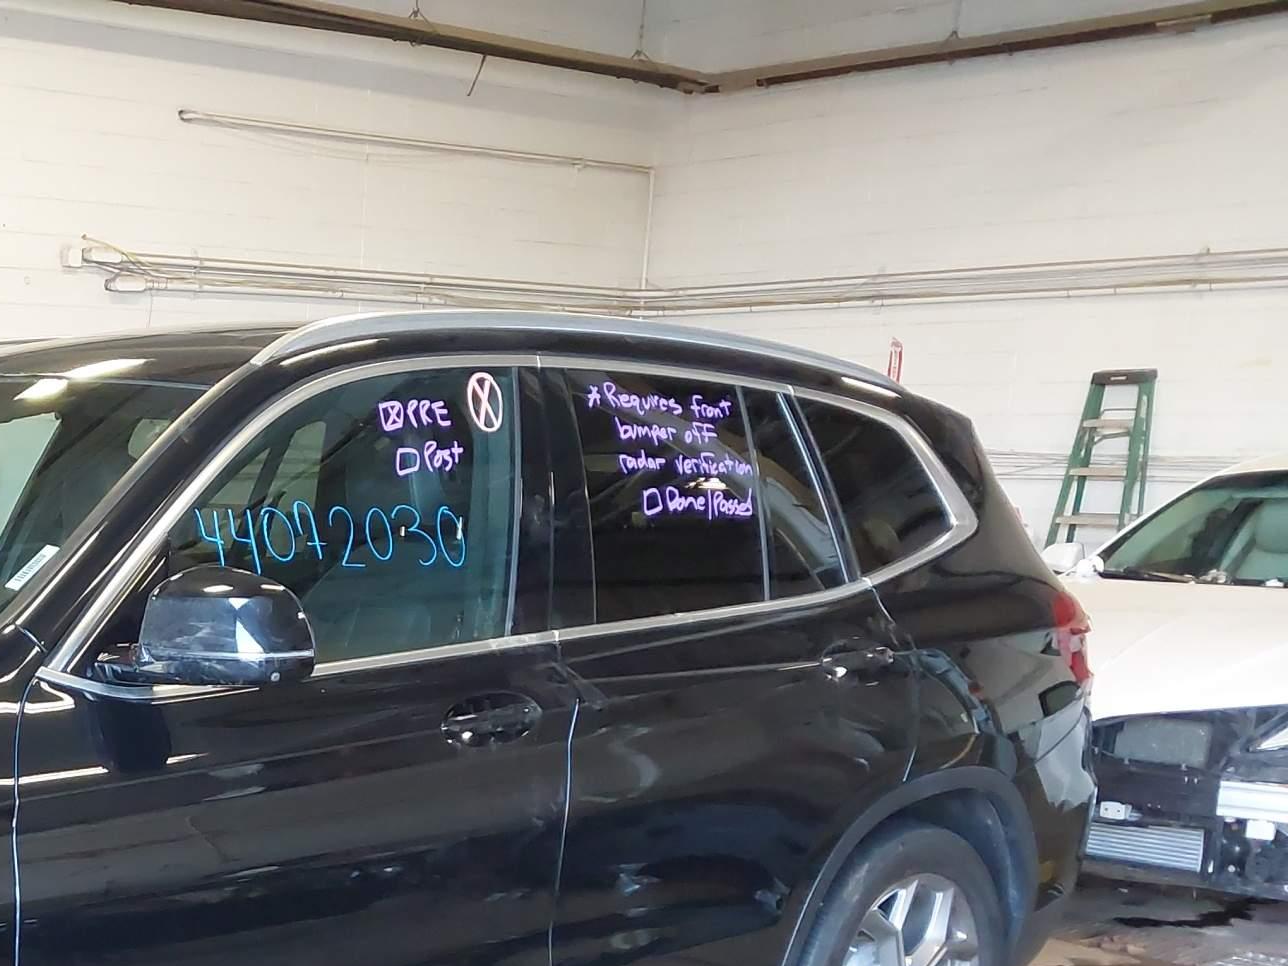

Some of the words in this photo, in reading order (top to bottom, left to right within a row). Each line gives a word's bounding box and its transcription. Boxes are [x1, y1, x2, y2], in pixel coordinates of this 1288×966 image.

[406, 399, 452, 430] PRE
[614, 416, 677, 446] bumper
[423, 440, 464, 472] Post
[618, 448, 666, 475] radar
[675, 452, 753, 476] verification
[193, 499, 466, 576] 44072030
